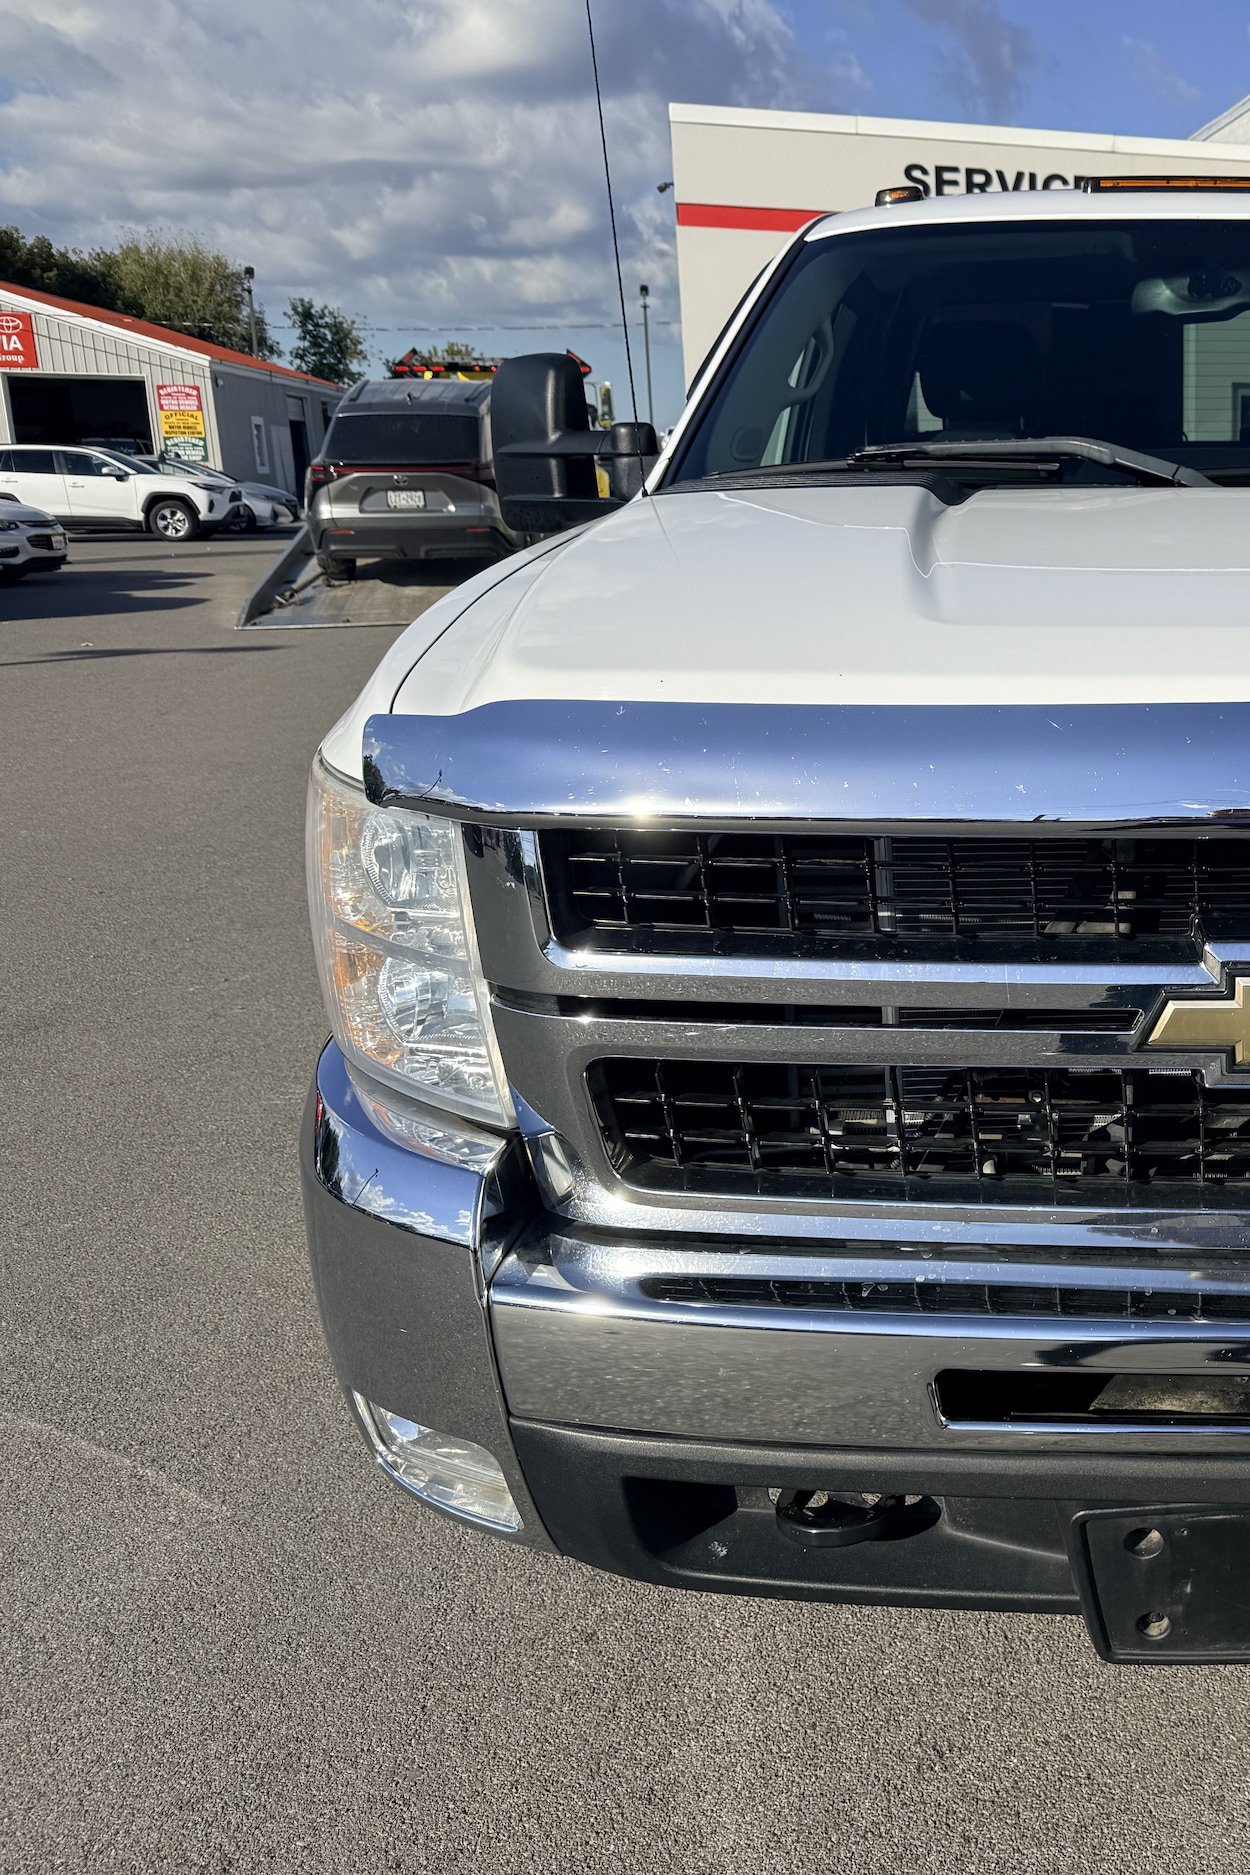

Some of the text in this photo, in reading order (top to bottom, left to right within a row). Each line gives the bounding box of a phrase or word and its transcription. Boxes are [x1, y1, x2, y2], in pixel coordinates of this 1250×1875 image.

[0, 334, 24, 351] IA
[0, 353, 25, 364] roup
[165, 411, 198, 421] OFFICIAL
